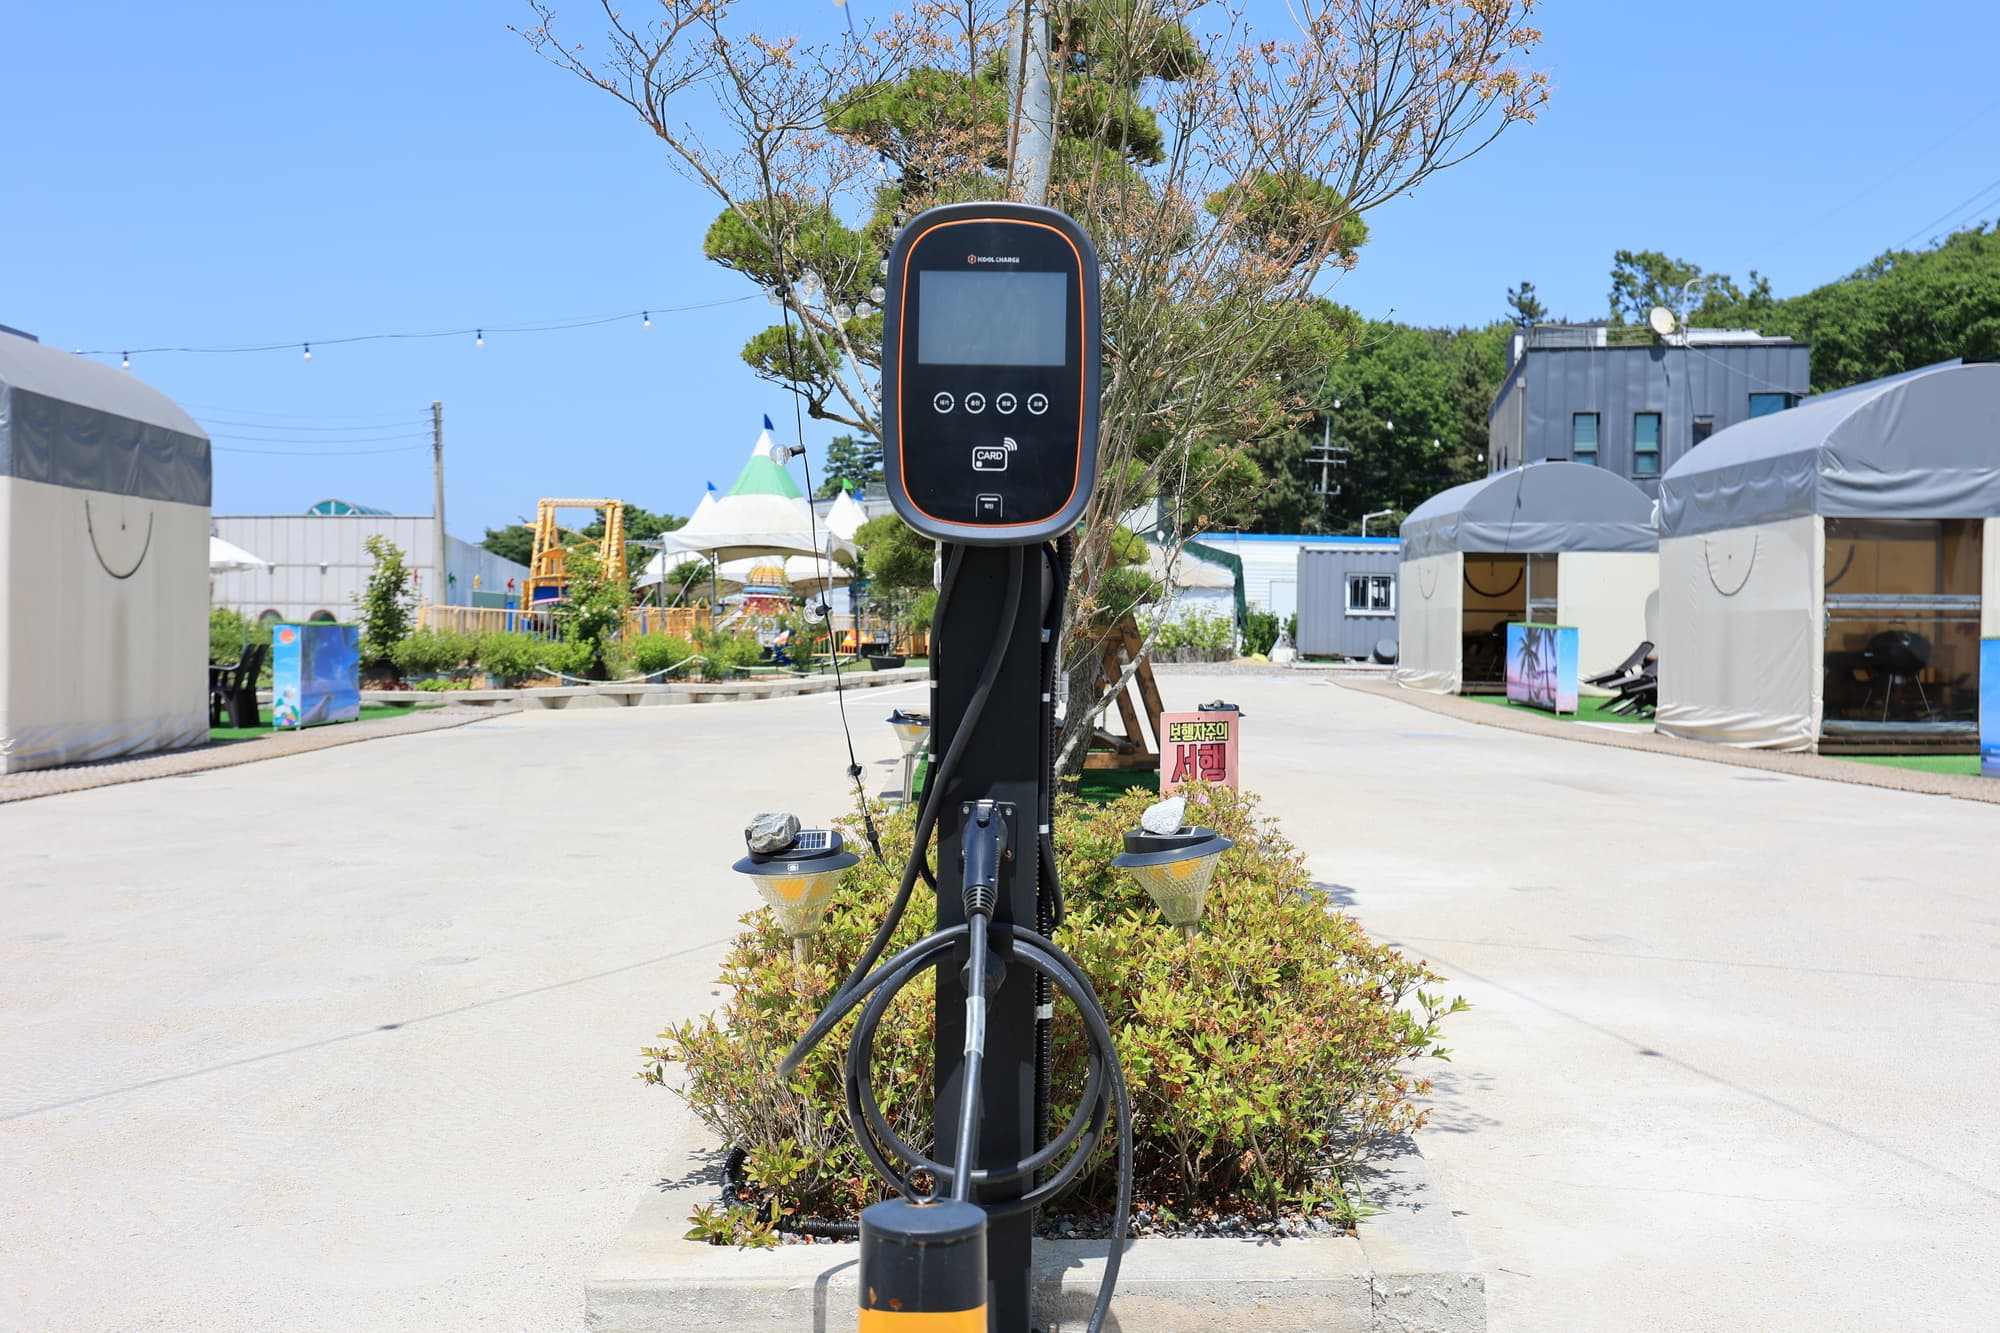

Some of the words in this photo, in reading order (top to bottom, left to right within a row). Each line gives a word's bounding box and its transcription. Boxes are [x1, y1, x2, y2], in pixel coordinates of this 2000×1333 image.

[977, 451, 1003, 460] CARD
[1169, 721, 1229, 742] 보행자주의
[1170, 743, 1226, 783] 서행
